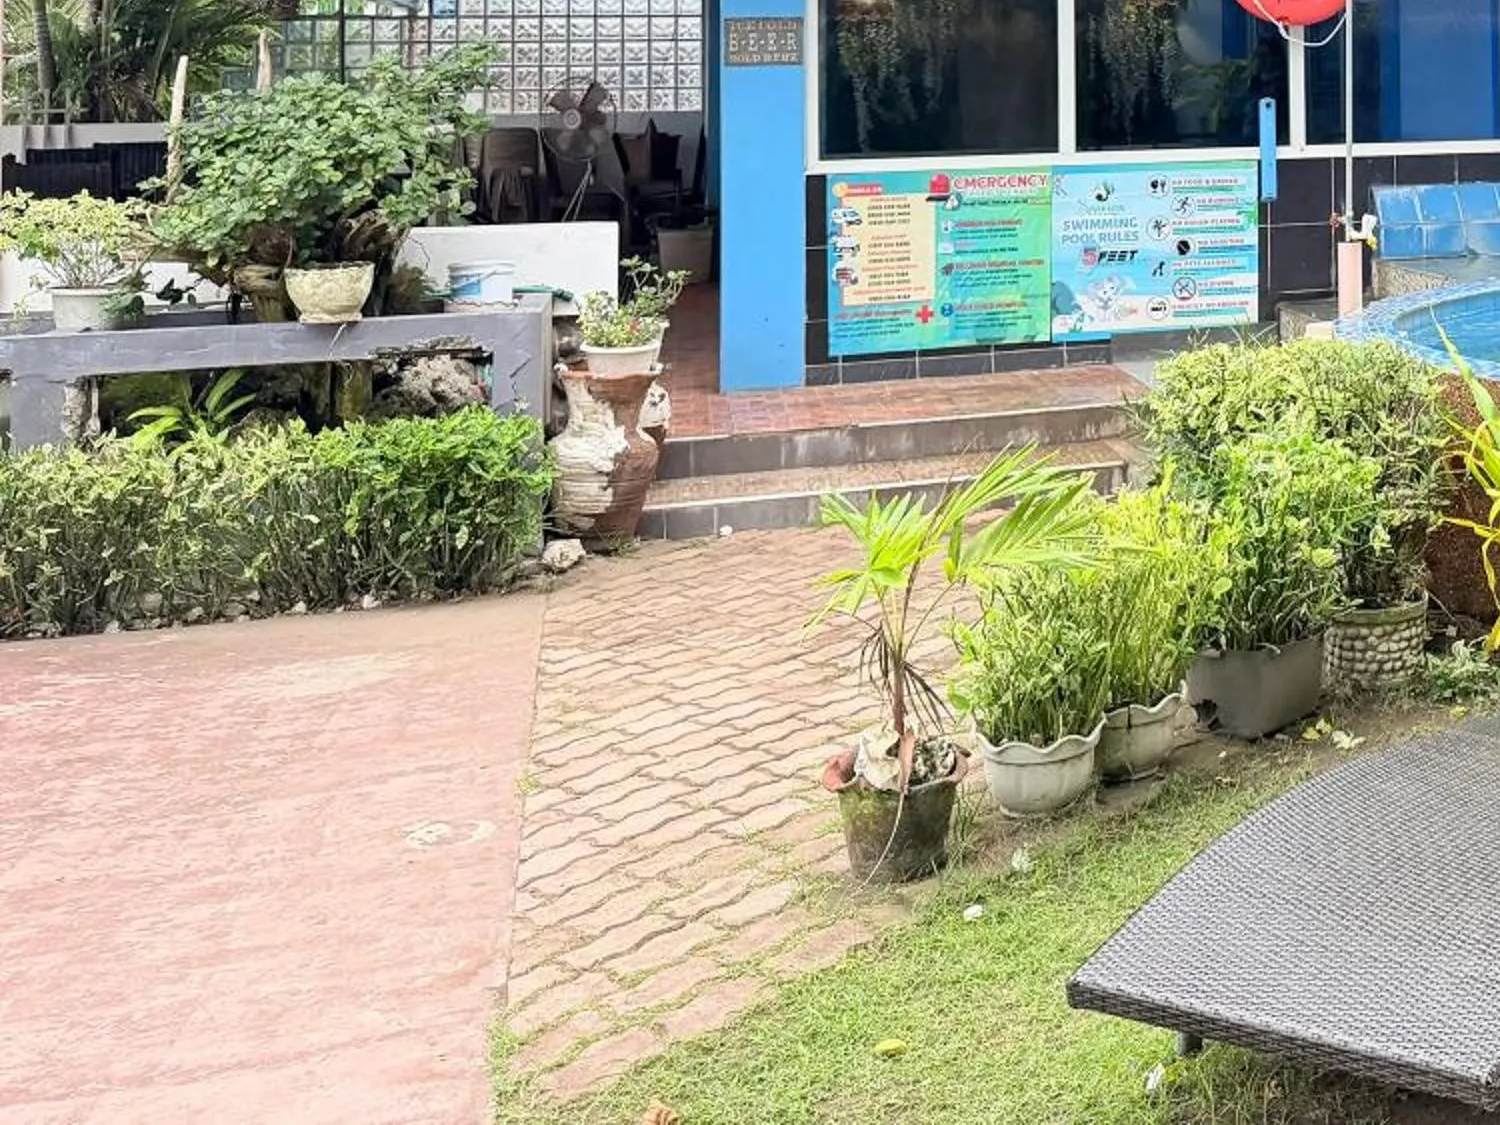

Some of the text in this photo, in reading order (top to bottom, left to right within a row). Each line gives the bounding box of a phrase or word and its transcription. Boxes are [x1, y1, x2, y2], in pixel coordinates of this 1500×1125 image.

[954, 174, 1047, 190] EMERGENCY
[1063, 216, 1138, 233] SWIMMING
[1062, 230, 1138, 245] POOL RULES
[1083, 246, 1138, 267] 5 FEET
